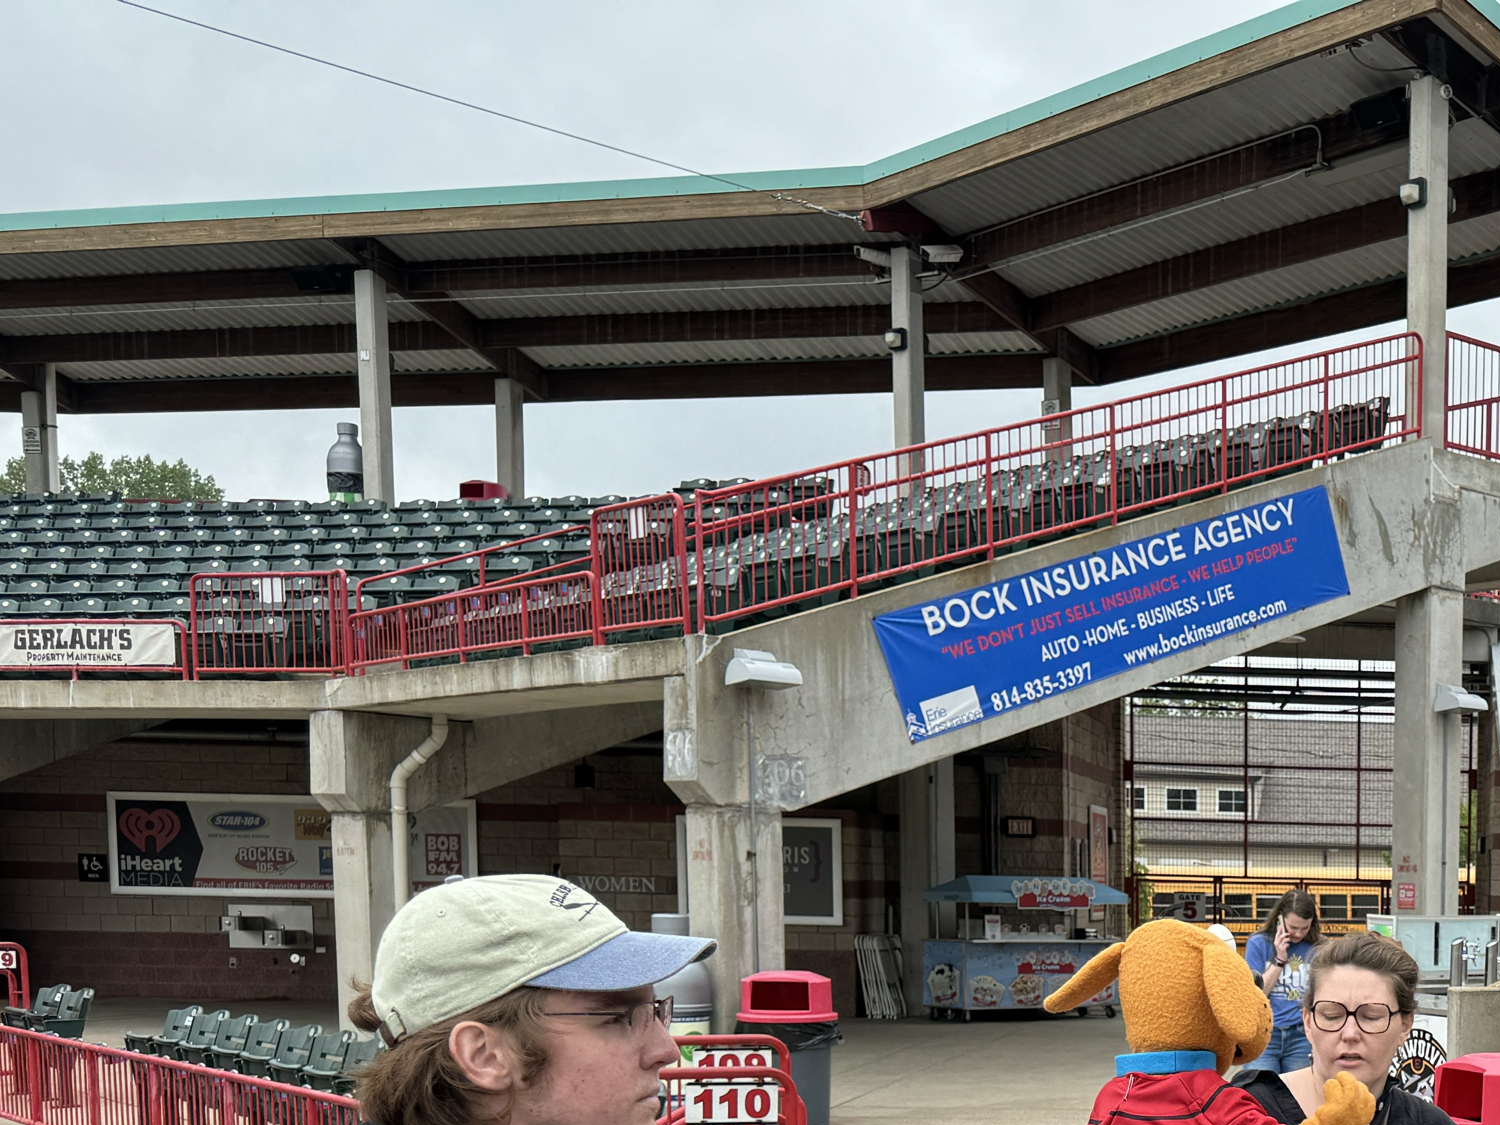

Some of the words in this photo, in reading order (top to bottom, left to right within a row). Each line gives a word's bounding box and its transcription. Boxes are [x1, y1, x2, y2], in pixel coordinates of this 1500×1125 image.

[921, 583, 1018, 637] BOCK
[1022, 533, 1187, 606] INSURANCE
[1194, 498, 1294, 555] AGENCY
[1029, 612, 1062, 636] JUST
[1066, 601, 1101, 623] SELL
[1101, 575, 1180, 611] INSURANCE
[1188, 565, 1210, 583] WE
[1212, 555, 1244, 575] HELP
[1041, 635, 1080, 663] AUTO
[1136, 595, 1200, 630] BUSINESS
[1206, 584, 1235, 607] LIFE
[1123, 599, 1288, 665] www.bockinsurance.com
[14, 629, 132, 650] GERLACH'S
[990, 662, 1092, 712] 814-835-3397
[925, 707, 948, 723] Erie
[1010, 819, 1031, 834] EXIT
[427, 836, 459, 850] BOB
[120, 854, 183, 872] iHeart
[238, 848, 292, 861] ROCKET
[428, 852, 459, 862] FM
[427, 862, 460, 876] 94.7
[120, 872, 184, 887] MEDIA
[577, 876, 656, 892] WOMEN
[1183, 902, 1198, 919] 5
[694, 1088, 771, 1119] 110
